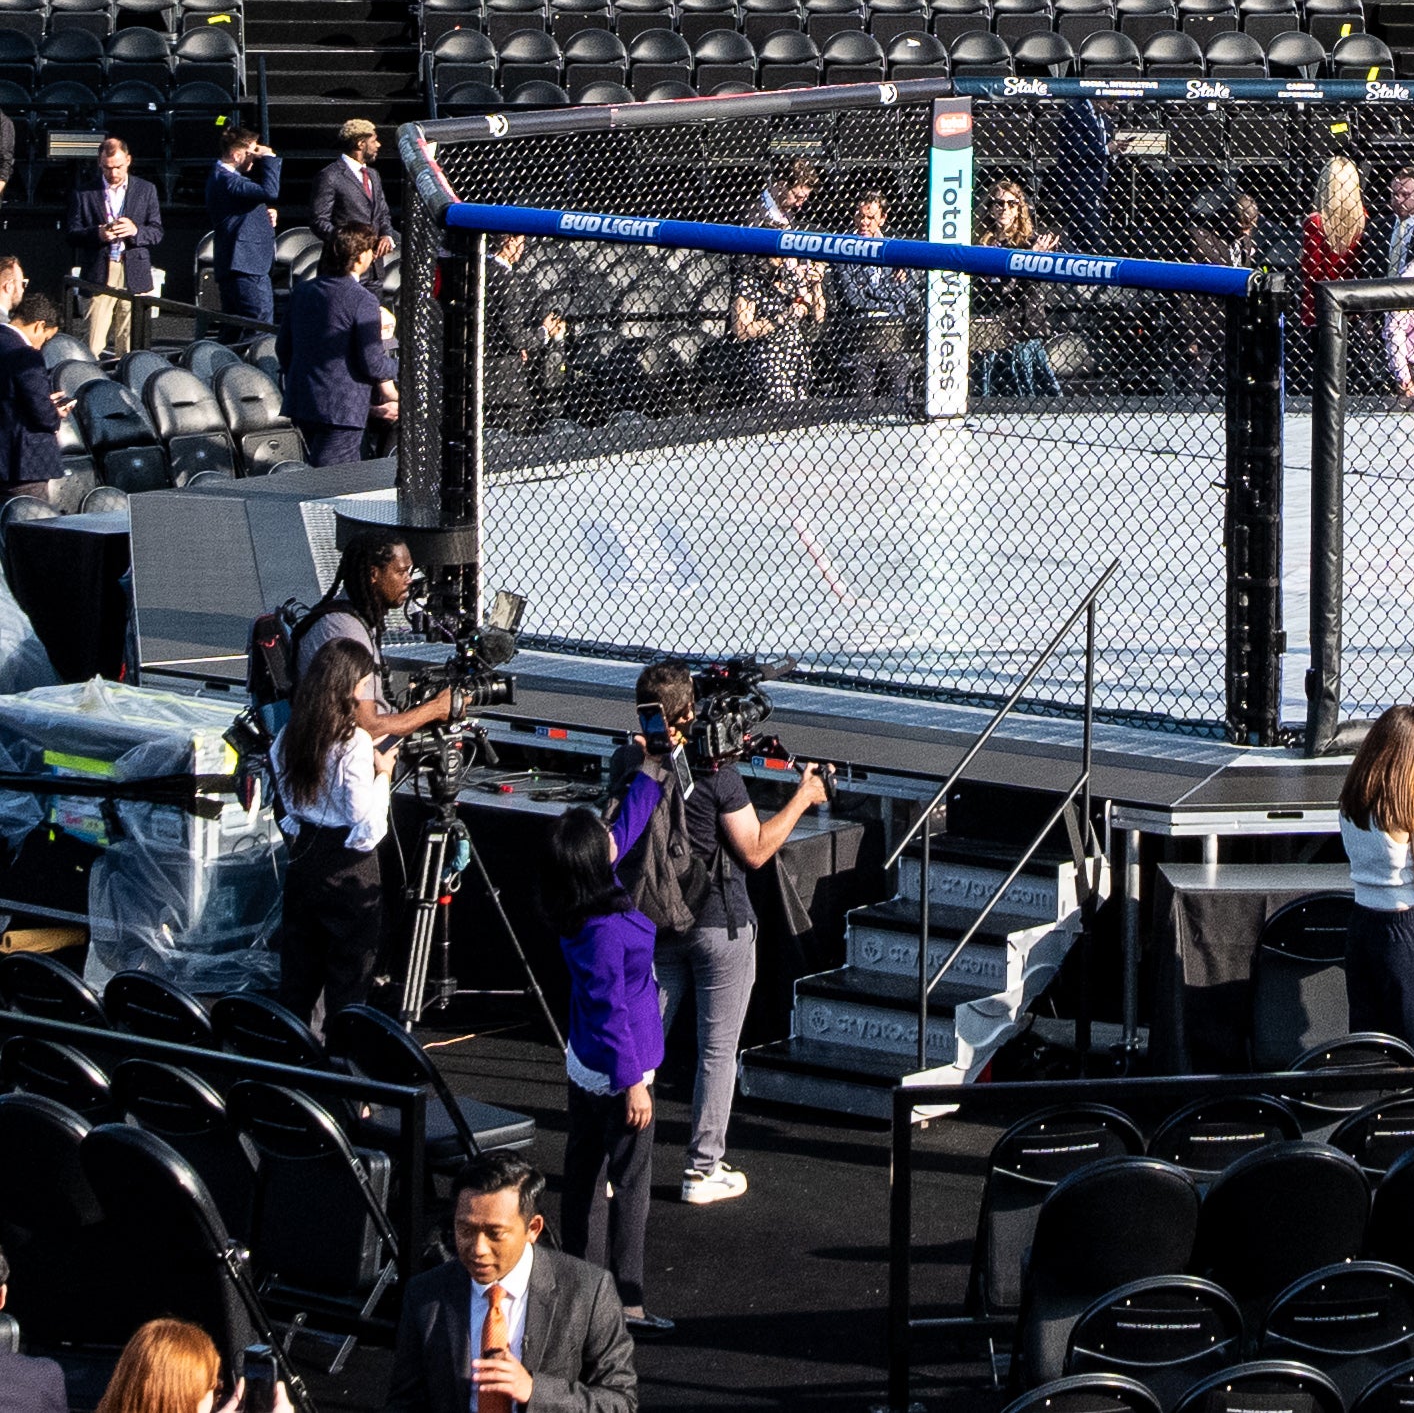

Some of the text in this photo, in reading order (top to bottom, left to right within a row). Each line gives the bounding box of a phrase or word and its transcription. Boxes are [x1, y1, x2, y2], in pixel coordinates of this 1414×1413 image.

[1003, 76, 1049, 97] Stake
[1185, 80, 1231, 100] Stake
[1366, 81, 1410, 101] Stake
[942, 169, 963, 245] Tota
[559, 213, 660, 238] BUD LIGHT
[780, 233, 883, 258] BUD LIGHT
[1009, 253, 1117, 279] BUD LIGHT
[940, 876, 1053, 908] crypt.com
[836, 1016, 952, 1049] crypto.cm
